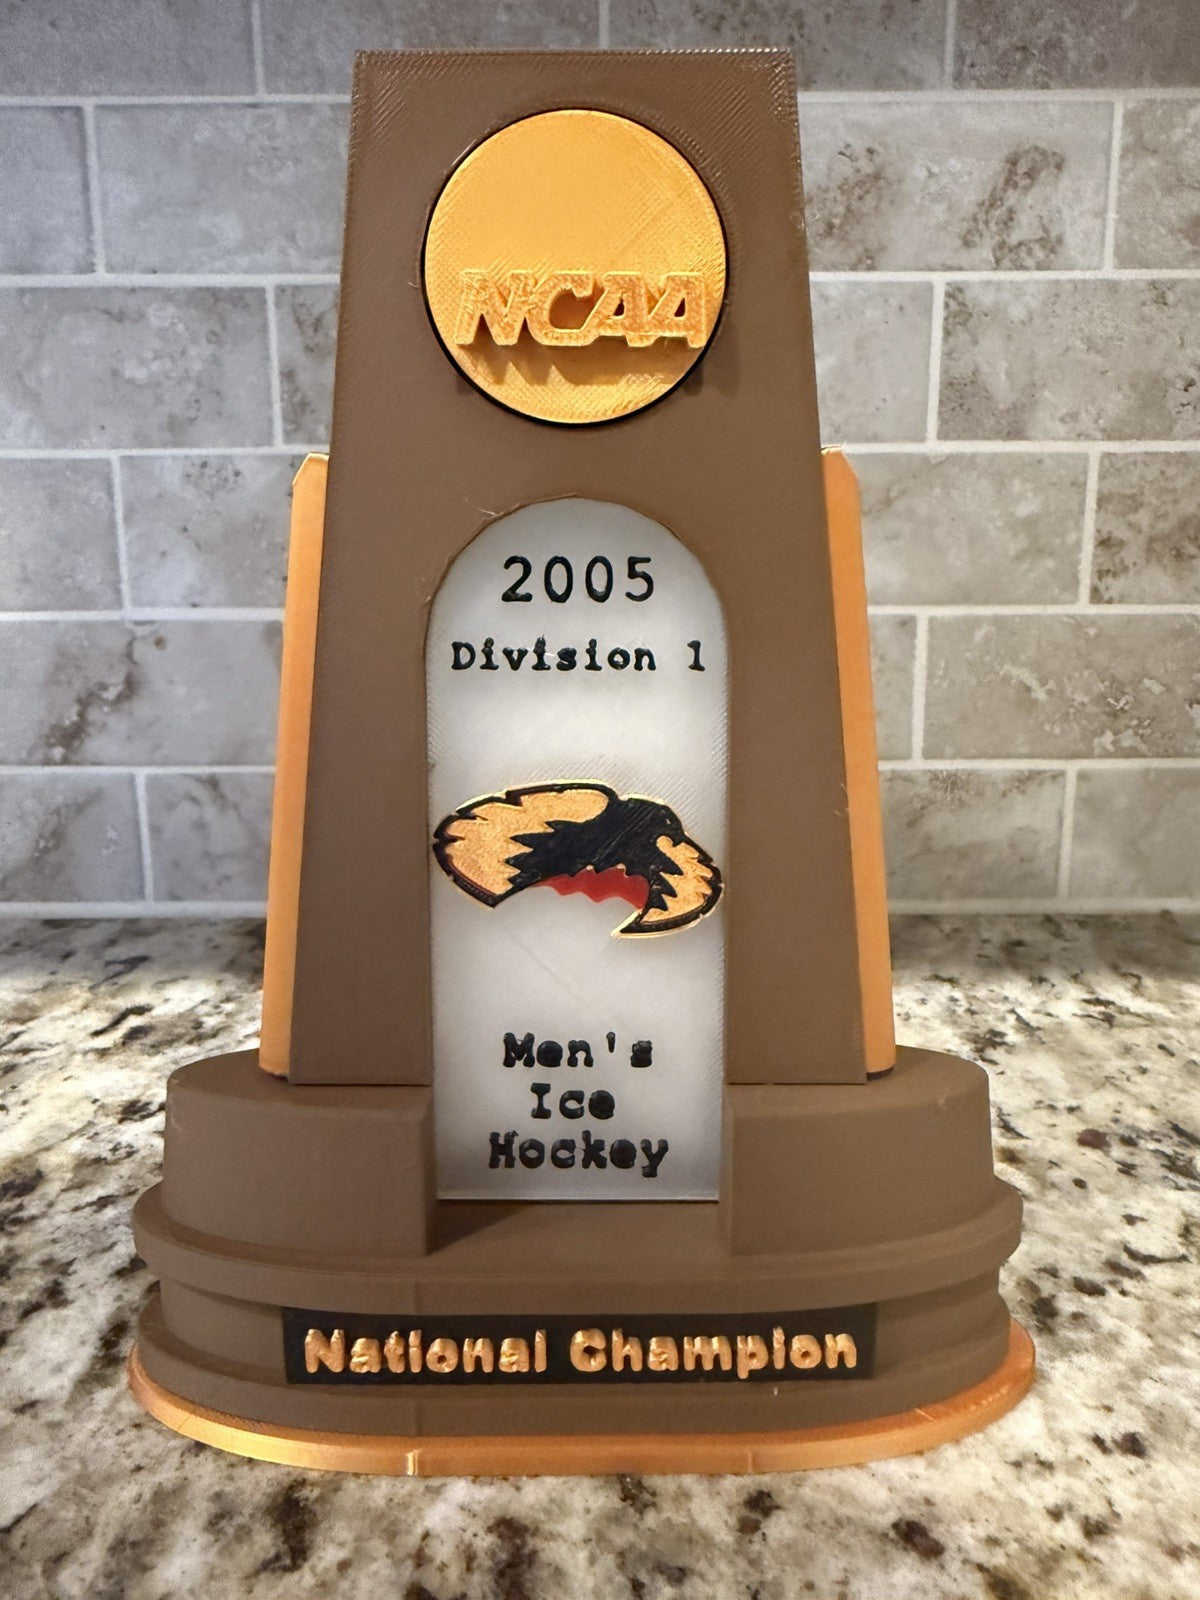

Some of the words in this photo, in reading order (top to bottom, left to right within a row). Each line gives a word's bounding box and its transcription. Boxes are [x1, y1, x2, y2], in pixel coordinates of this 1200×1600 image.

[454, 269, 707, 348] NCAA
[501, 555, 655, 604] 2005
[450, 636, 657, 672] Division
[687, 640, 706, 672] 1
[502, 1031, 653, 1069] Men's
[529, 1082, 616, 1120] Ice
[488, 1129, 670, 1178] Hockey
[304, 1328, 547, 1374] National
[569, 1326, 858, 1380] Champion
